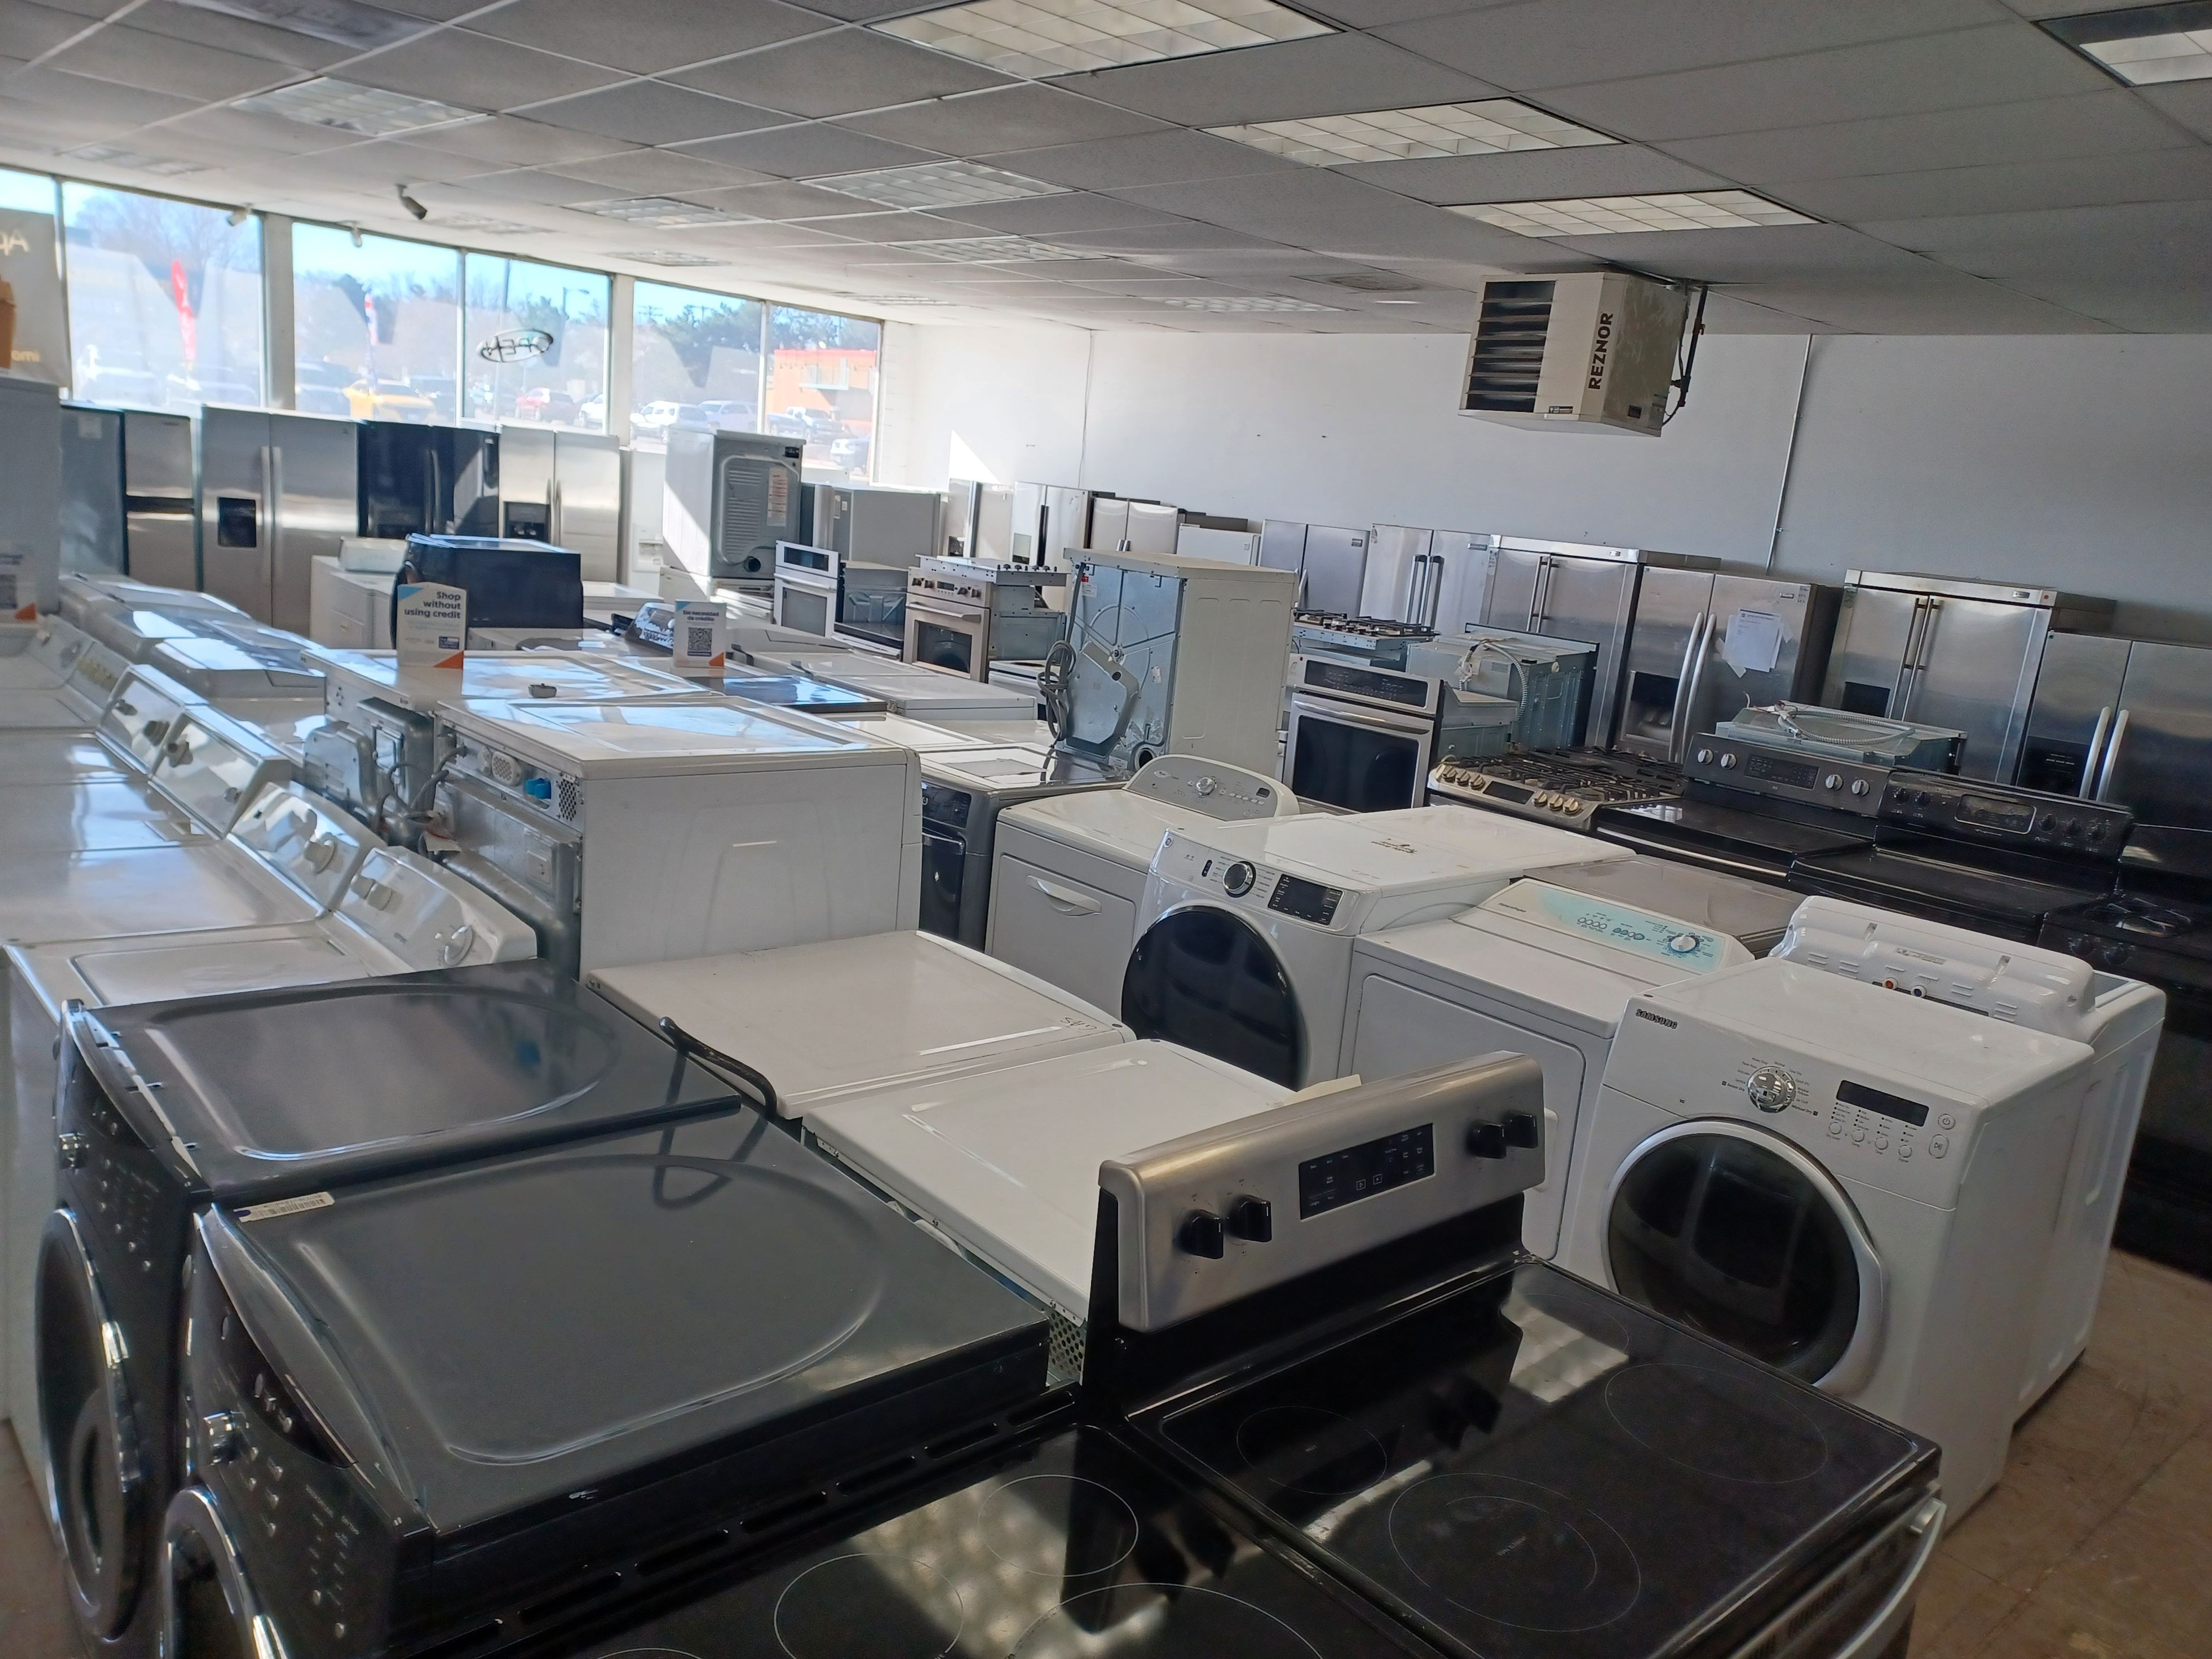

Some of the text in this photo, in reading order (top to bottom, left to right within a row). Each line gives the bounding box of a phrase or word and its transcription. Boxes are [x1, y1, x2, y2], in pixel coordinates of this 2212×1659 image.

[1588, 312, 1614, 390] REZNOR
[436, 591, 461, 601] Shop
[423, 601, 461, 609] without
[404, 608, 461, 619] using credit
[1635, 1008, 1678, 1029] SAMSUNG
